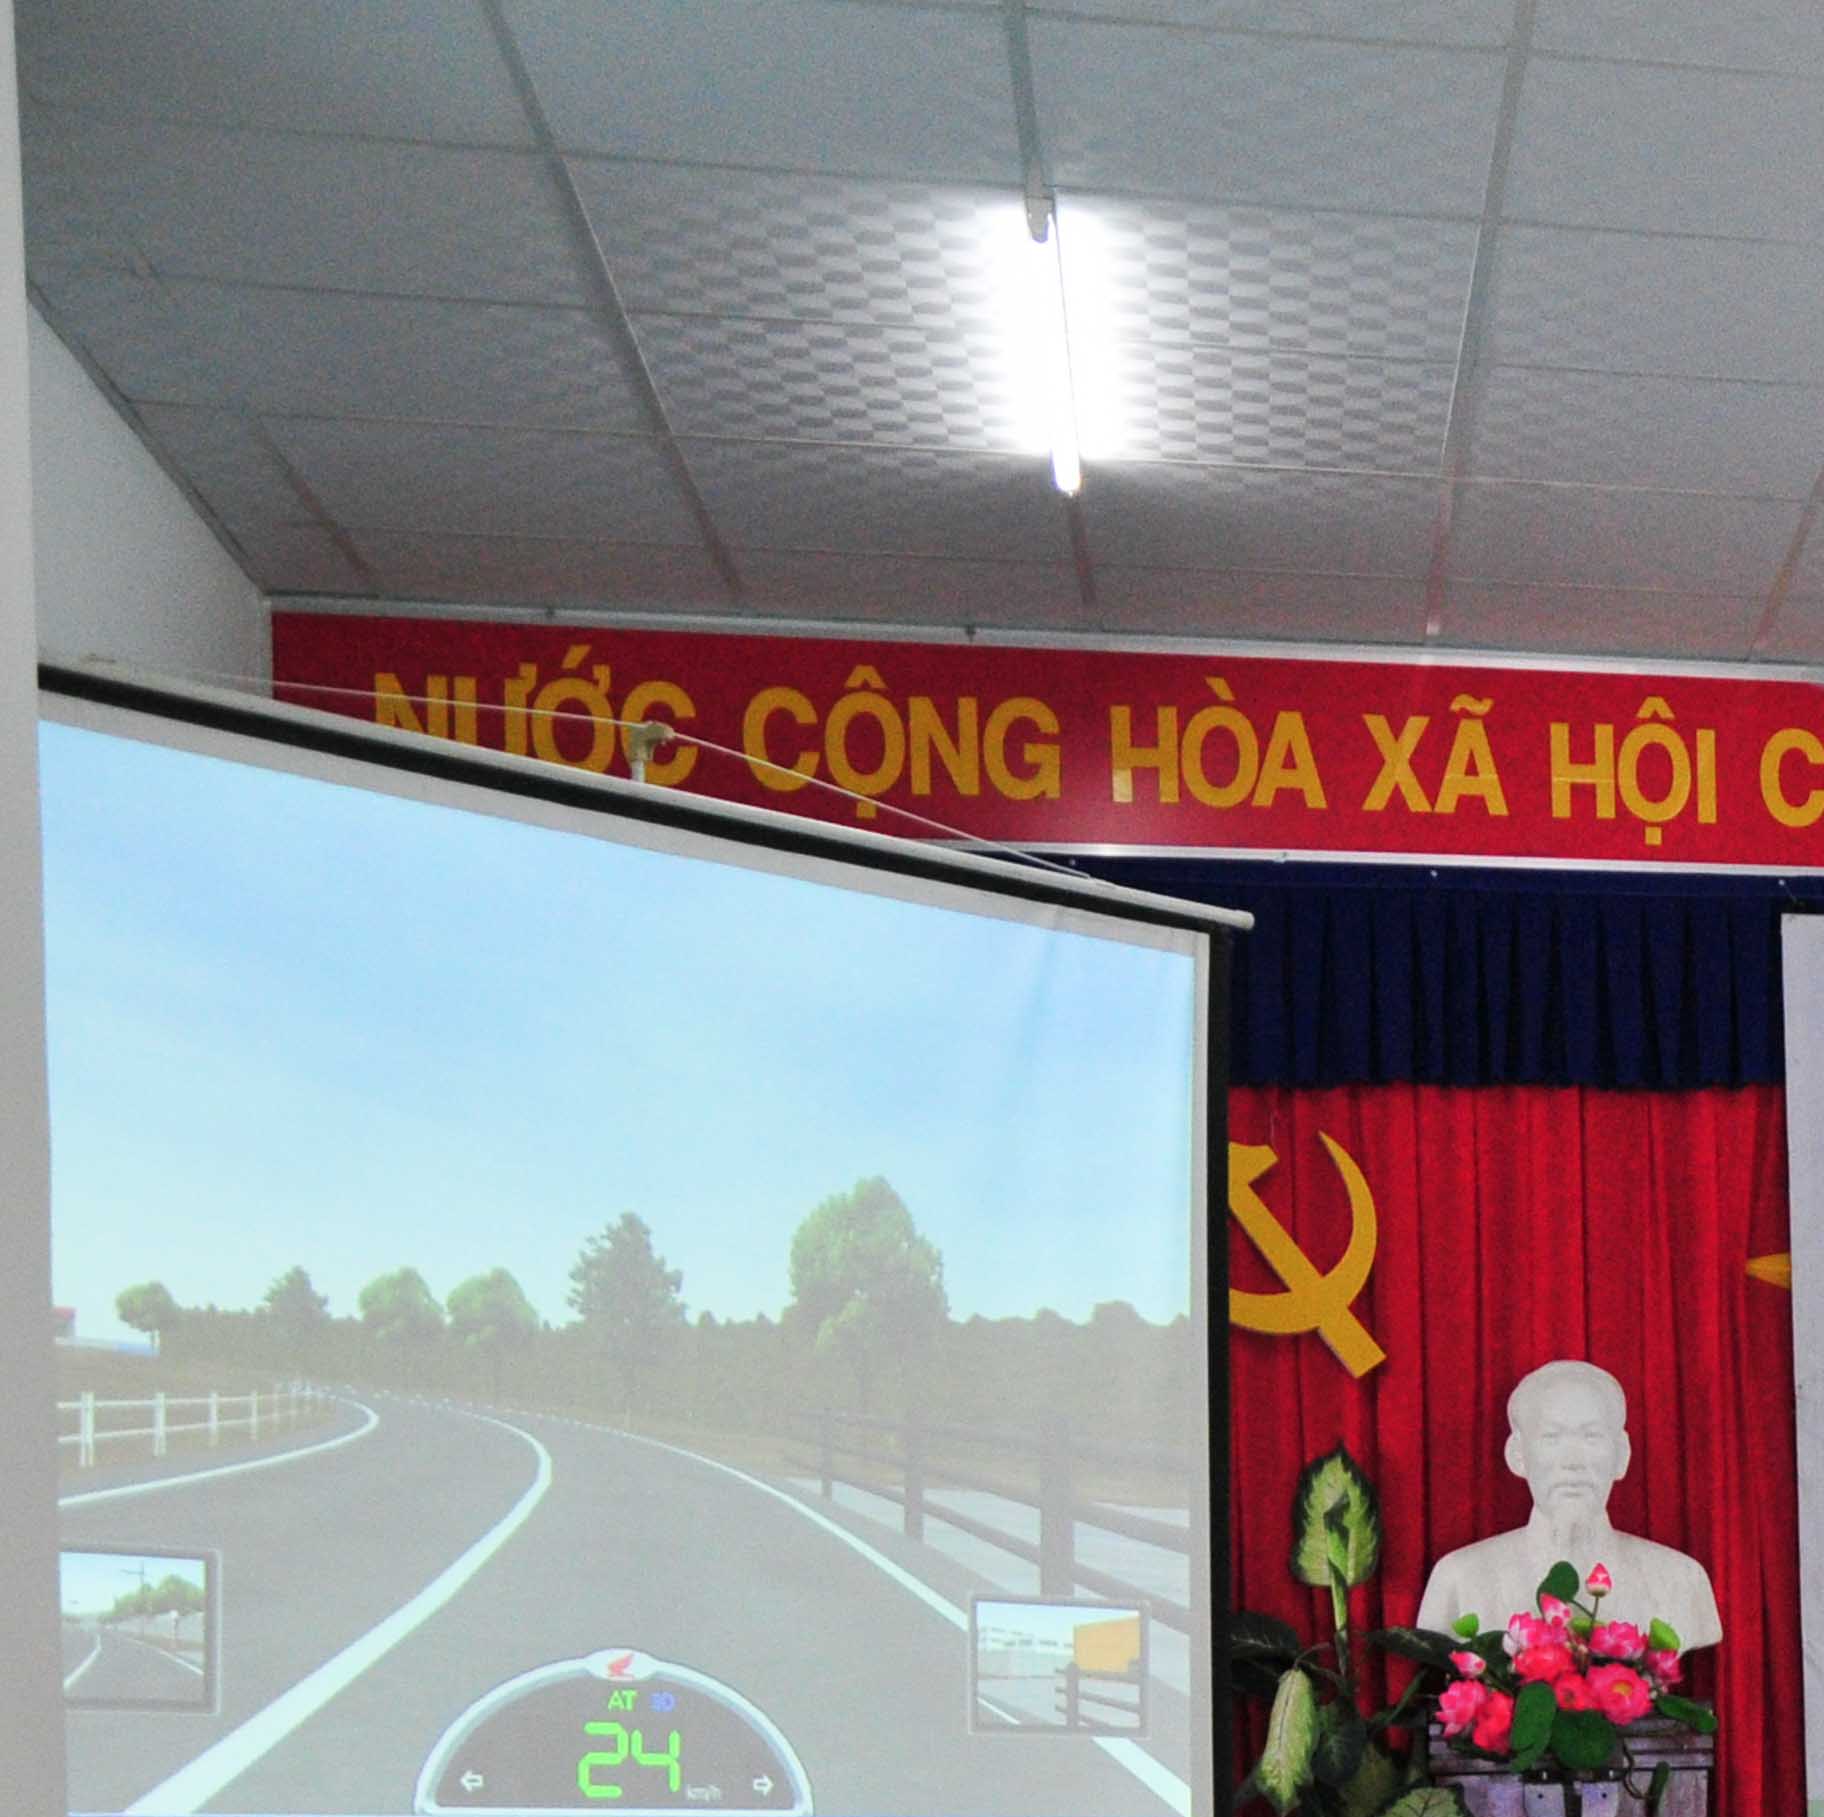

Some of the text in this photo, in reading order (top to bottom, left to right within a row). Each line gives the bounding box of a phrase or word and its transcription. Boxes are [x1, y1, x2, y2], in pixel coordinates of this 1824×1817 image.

[374, 646, 697, 786] NƯỚC
[742, 665, 1060, 820] CỘNG
[1112, 677, 1326, 808] HÒA
[1362, 693, 1509, 817] XÃ
[1550, 696, 1718, 846] HỘI
[607, 1689, 638, 1711] AT
[577, 1721, 681, 1798] 24
